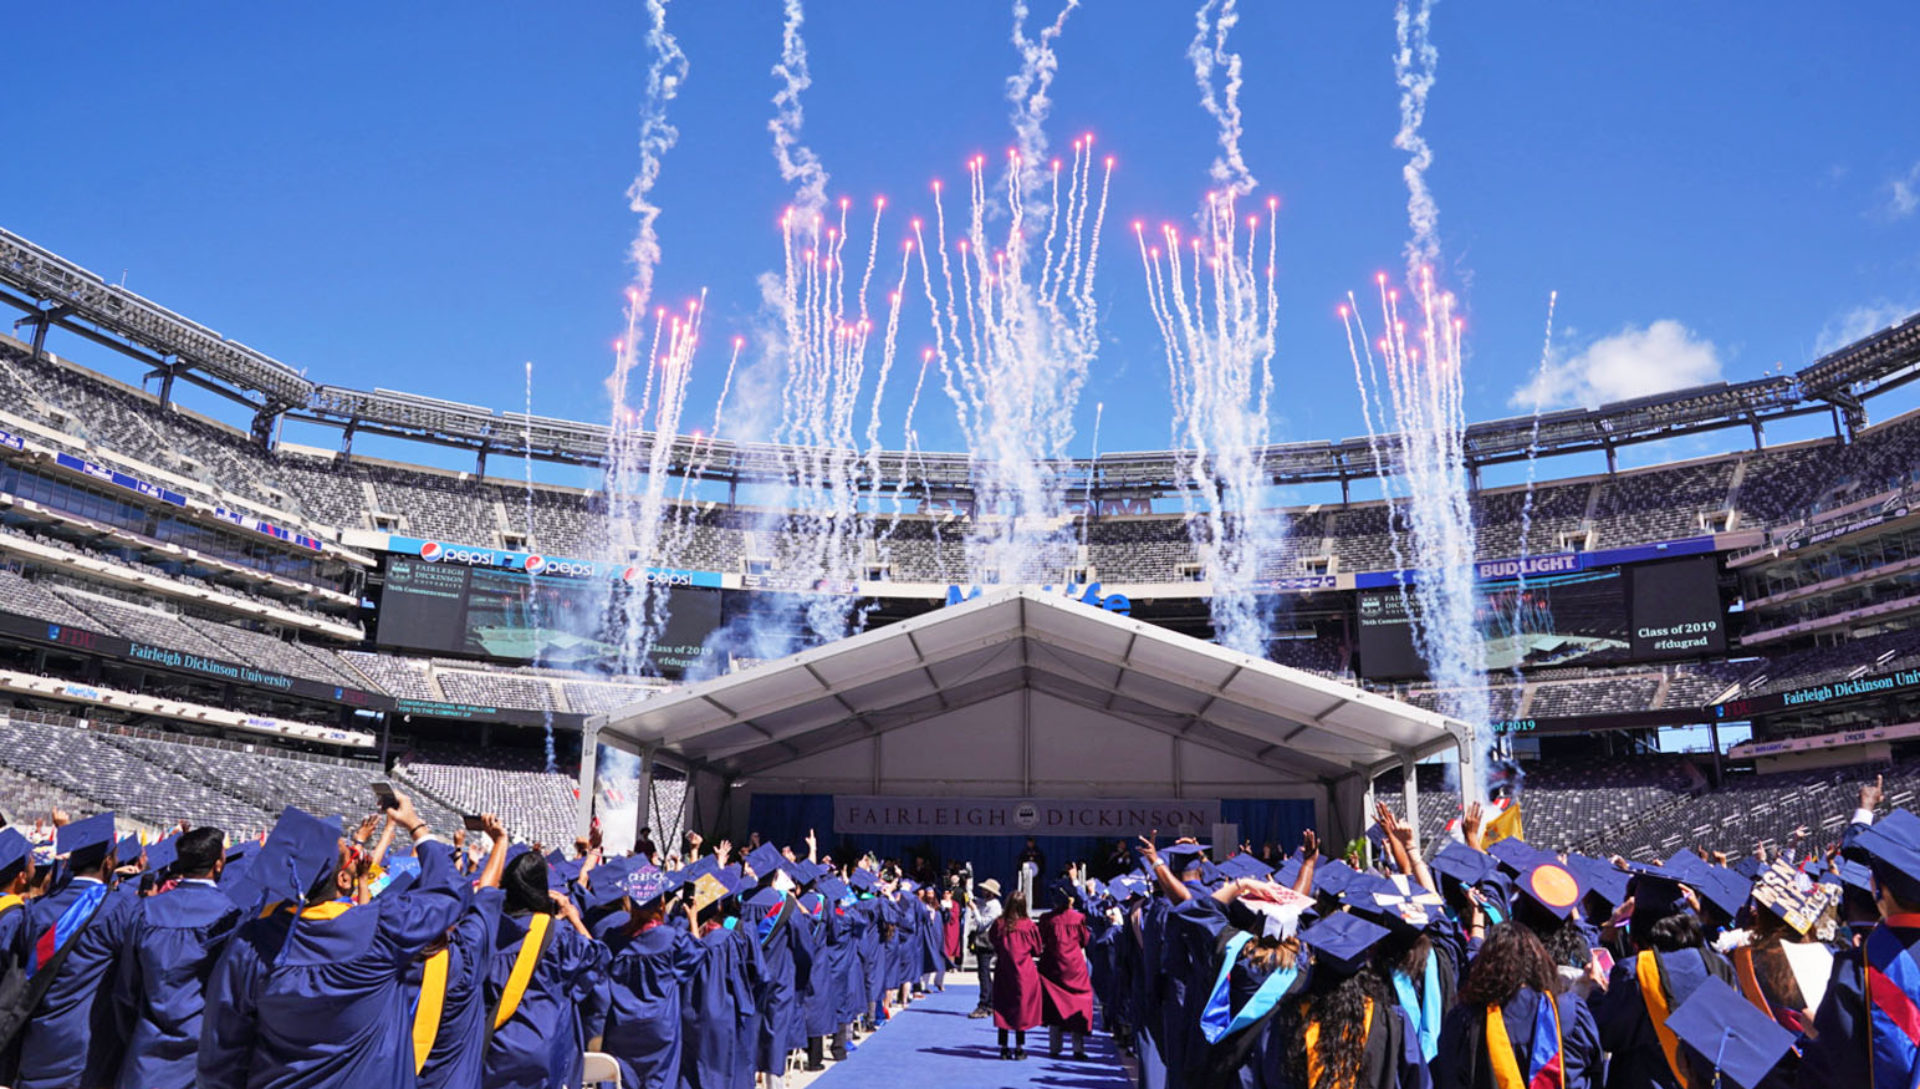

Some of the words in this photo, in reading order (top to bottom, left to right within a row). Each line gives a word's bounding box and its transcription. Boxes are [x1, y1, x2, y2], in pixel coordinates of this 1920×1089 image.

[444, 548, 494, 566] pepsi
[415, 564, 465, 576] FAIRLEIGH
[546, 561, 594, 577] pepsi
[1480, 561, 1518, 578] BUD
[1520, 555, 1576, 574] LIGHT
[646, 571, 693, 586] pepsi
[1638, 627, 1669, 638] Class
[1670, 624, 1684, 635] of
[1685, 620, 1717, 633] 2019
[674, 645, 686, 654] of
[1654, 636, 1709, 650] #fdugrad
[129, 642, 182, 667] Fairleigh
[183, 655, 239, 678] Dickinson
[240, 667, 294, 691] University
[1783, 686, 1832, 705] Fairleigh
[1835, 679, 1893, 697] Dickinson
[1492, 721, 1505, 732] of
[1507, 719, 1536, 731] 2019
[849, 807, 1006, 826] FAIRLEIGH
[1047, 808, 1206, 827] DICKINSON
